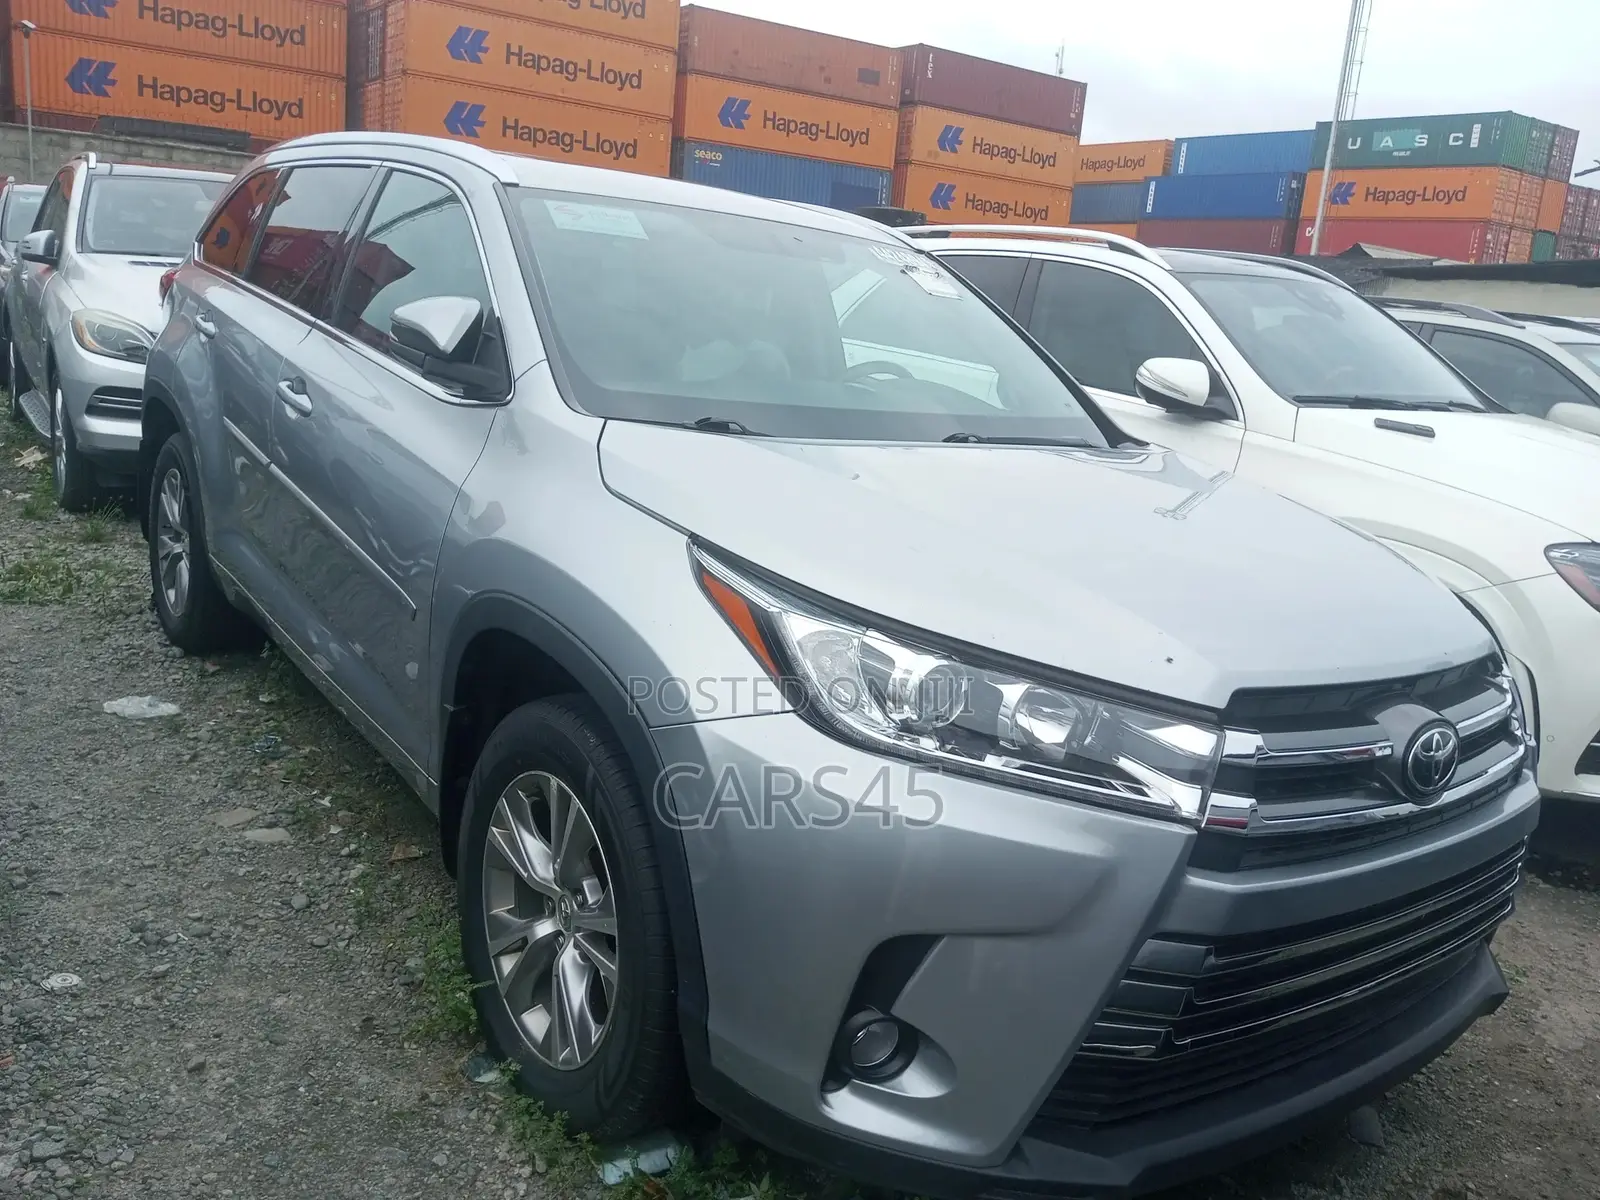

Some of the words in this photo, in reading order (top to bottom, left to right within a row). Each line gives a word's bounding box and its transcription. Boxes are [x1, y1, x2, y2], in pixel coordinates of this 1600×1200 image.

[138, 0, 306, 47] Hapag-Lloyd
[505, 43, 642, 91] Hapag-Lloyd
[137, 74, 304, 121] Hapag-Lloyd
[502, 116, 638, 160] Hapag-Lloyd
[763, 110, 870, 146] Hapag-Lloyd
[694, 149, 723, 161] seaco
[972, 137, 1057, 168] Hapag-Lloyd
[1080, 155, 1146, 173] Hapag-Lloyd
[965, 192, 1049, 222] Hapag-Lloyd
[1364, 186, 1468, 205] Hapag-Lloyd
